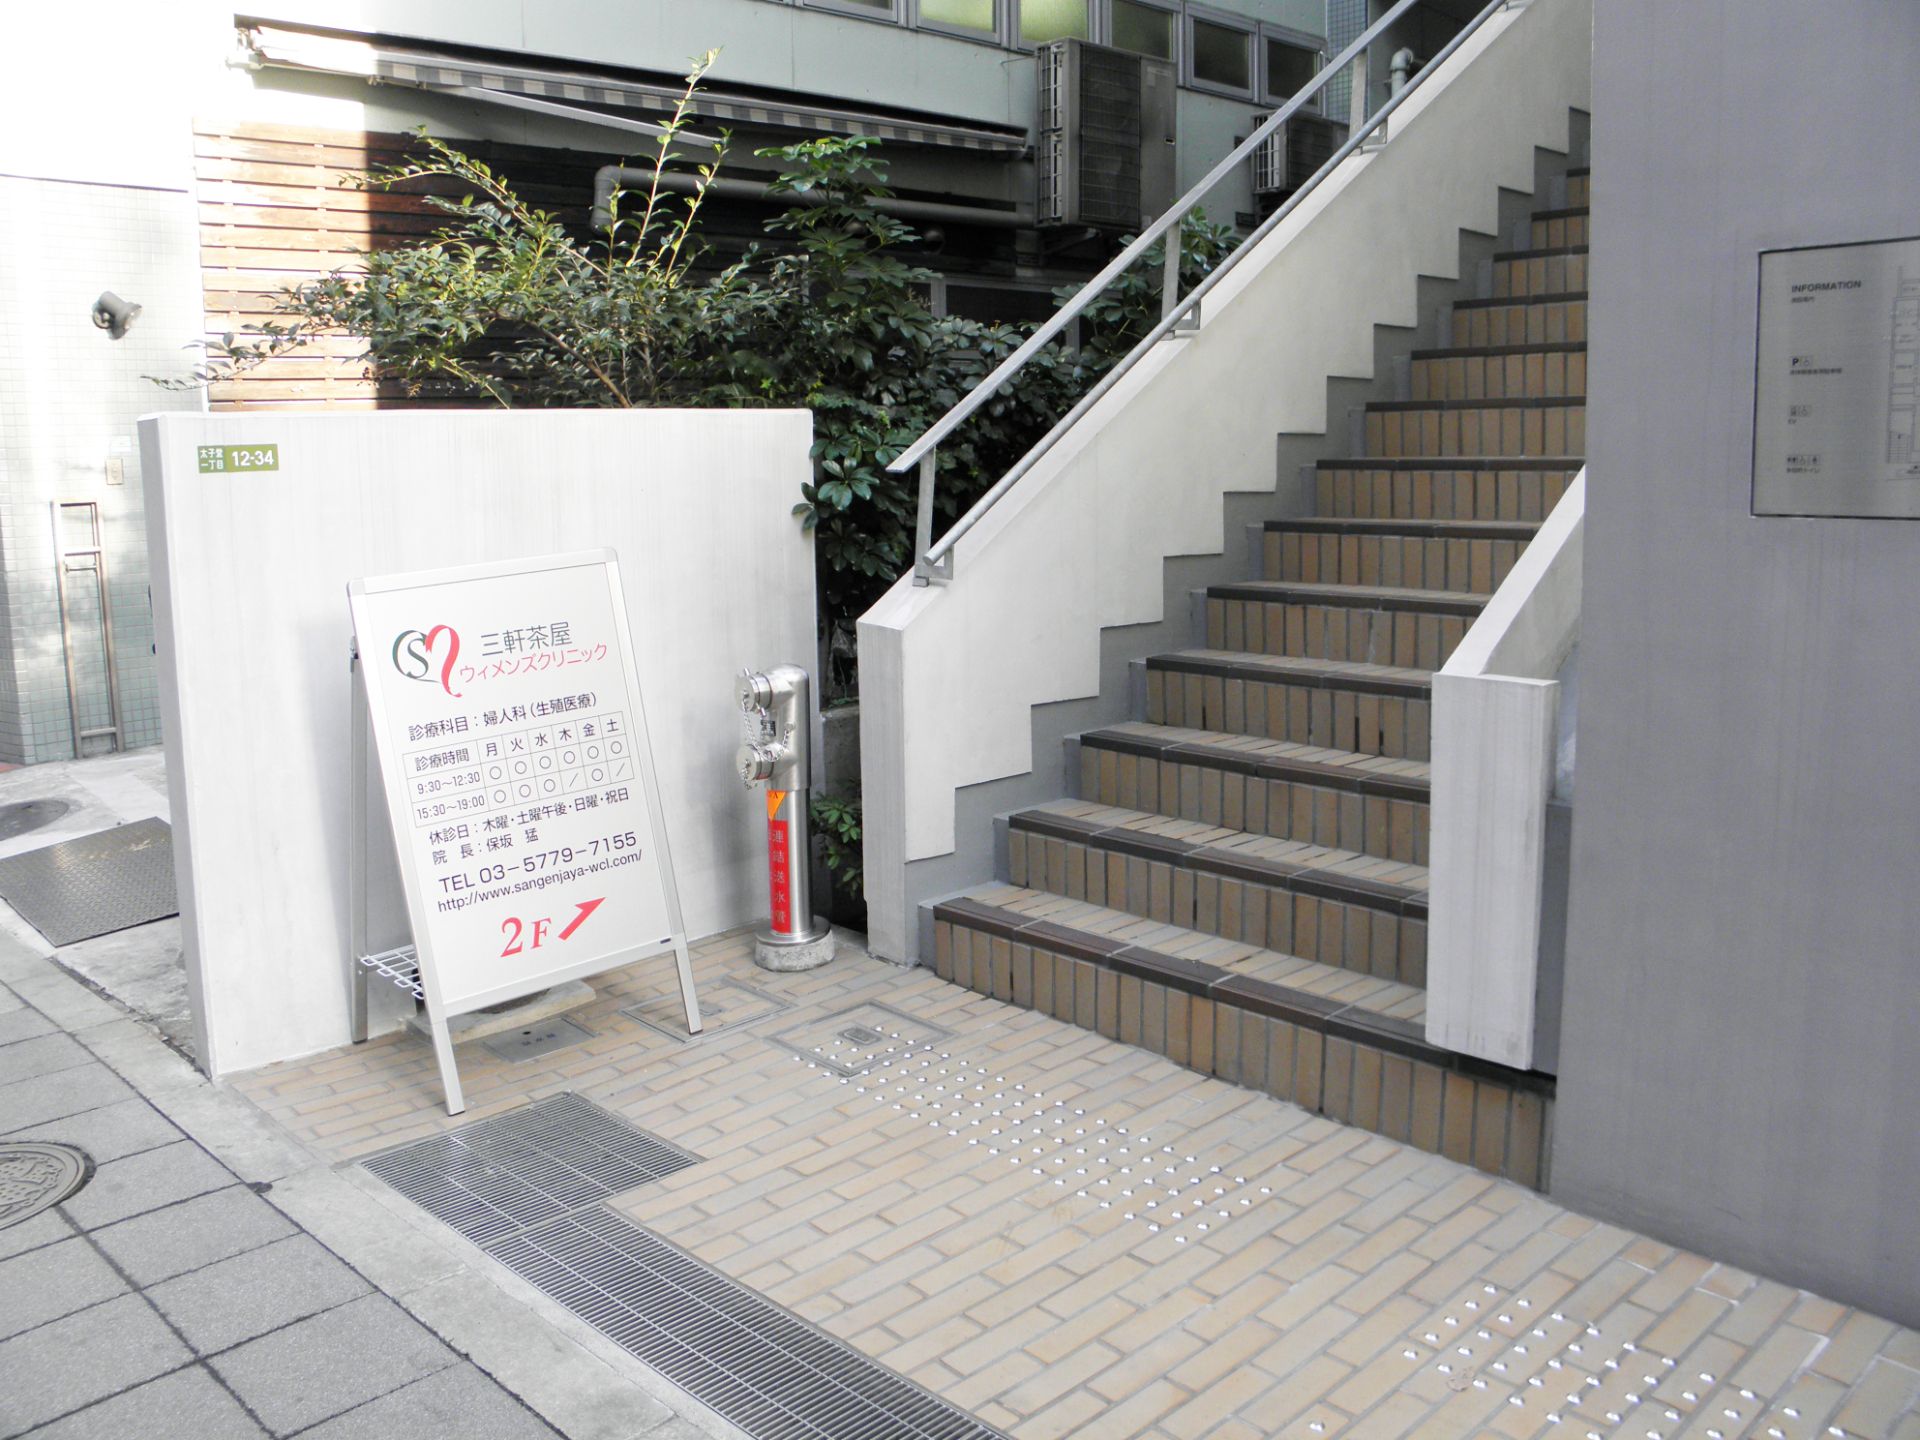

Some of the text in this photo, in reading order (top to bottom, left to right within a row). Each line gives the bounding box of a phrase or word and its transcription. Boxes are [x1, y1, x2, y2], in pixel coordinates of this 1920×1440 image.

[1792, 280, 1861, 292] INFORMATION
[200, 448, 224, 459] 太子堂
[200, 460, 224, 470] 一丁目
[232, 450, 274, 467] 12-34
[480, 621, 572, 657] 三軒茶屋
[459, 642, 607, 683] ウィメンズクリニック
[415, 718, 620, 772] 診療時間 月 火 水 木 金 土
[438, 849, 643, 912] http://www.sangenjaya-wcl.com/
[439, 872, 475, 894] TEL
[500, 916, 552, 958] 2F
